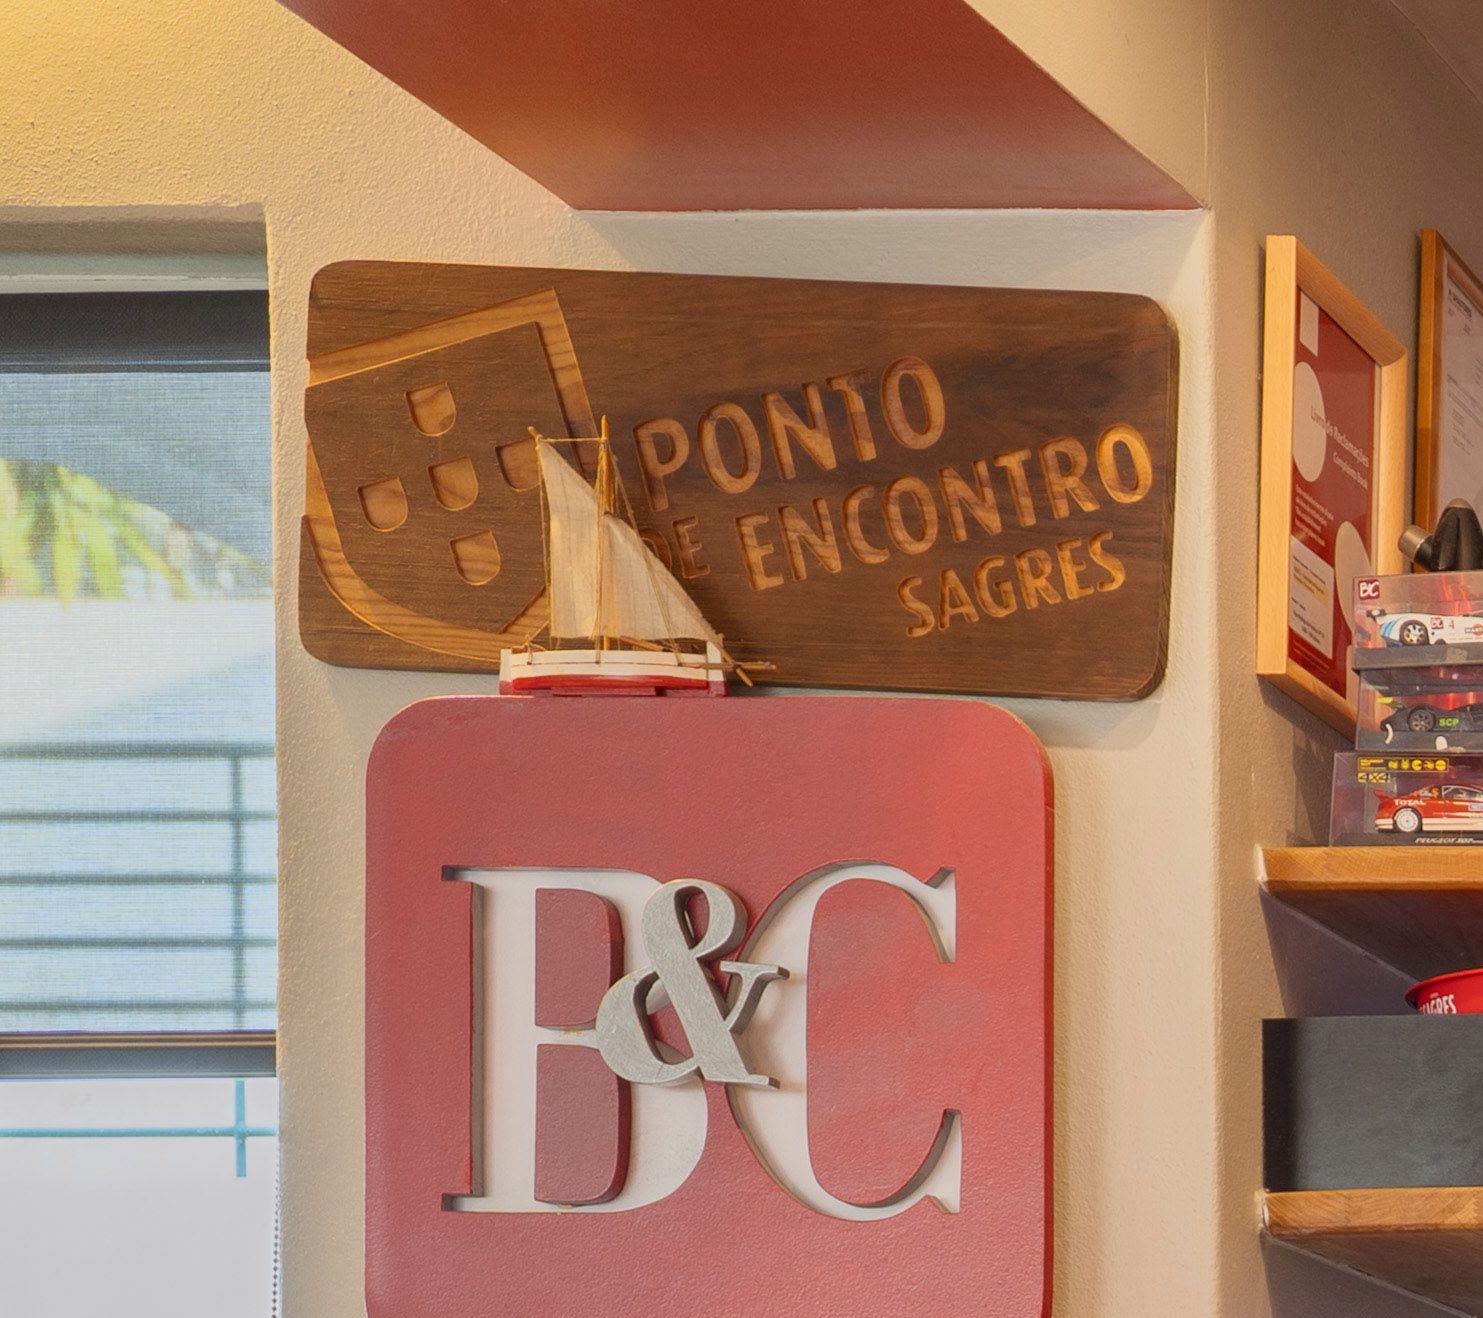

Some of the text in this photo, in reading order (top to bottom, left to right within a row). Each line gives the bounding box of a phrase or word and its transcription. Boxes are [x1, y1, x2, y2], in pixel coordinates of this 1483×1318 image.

[633, 356, 946, 512] PONTO
[736, 423, 1154, 593] ENCONTRO
[897, 529, 1126, 637] SAGRES
[442, 858, 963, 1222] B&C
